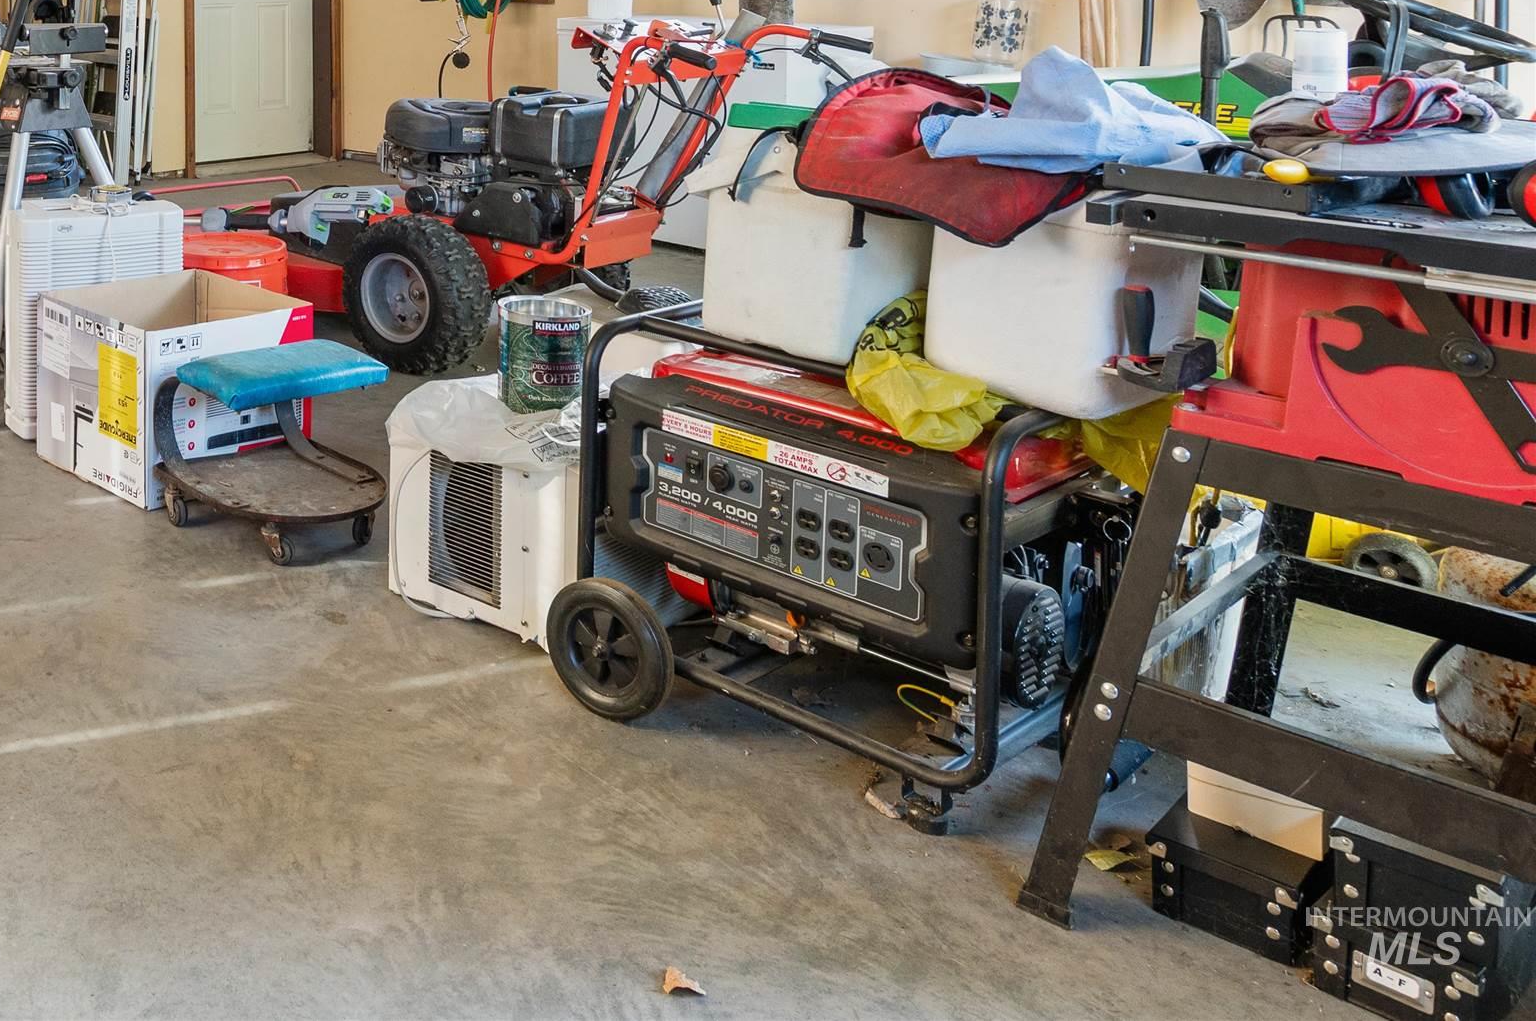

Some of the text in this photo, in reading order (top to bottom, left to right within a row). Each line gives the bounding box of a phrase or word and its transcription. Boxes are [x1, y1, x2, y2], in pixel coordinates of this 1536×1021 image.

[535, 321, 580, 331] KIRKLAND
[685, 384, 914, 456] PREDATOR 4,000
[689, 425, 712, 435] HOURS
[773, 455, 819, 475] TOTAL MAX
[779, 450, 813, 466] 26 AMPS
[92, 467, 138, 499] FRIGIDAIRE
[658, 481, 702, 504] 3,200
[712, 500, 758, 523] 4,000
[740, 519, 758, 529] WATTS
[866, 511, 911, 528] GENERATORS
[1372, 966, 1383, 977] A
[1397, 977, 1408, 988] F
